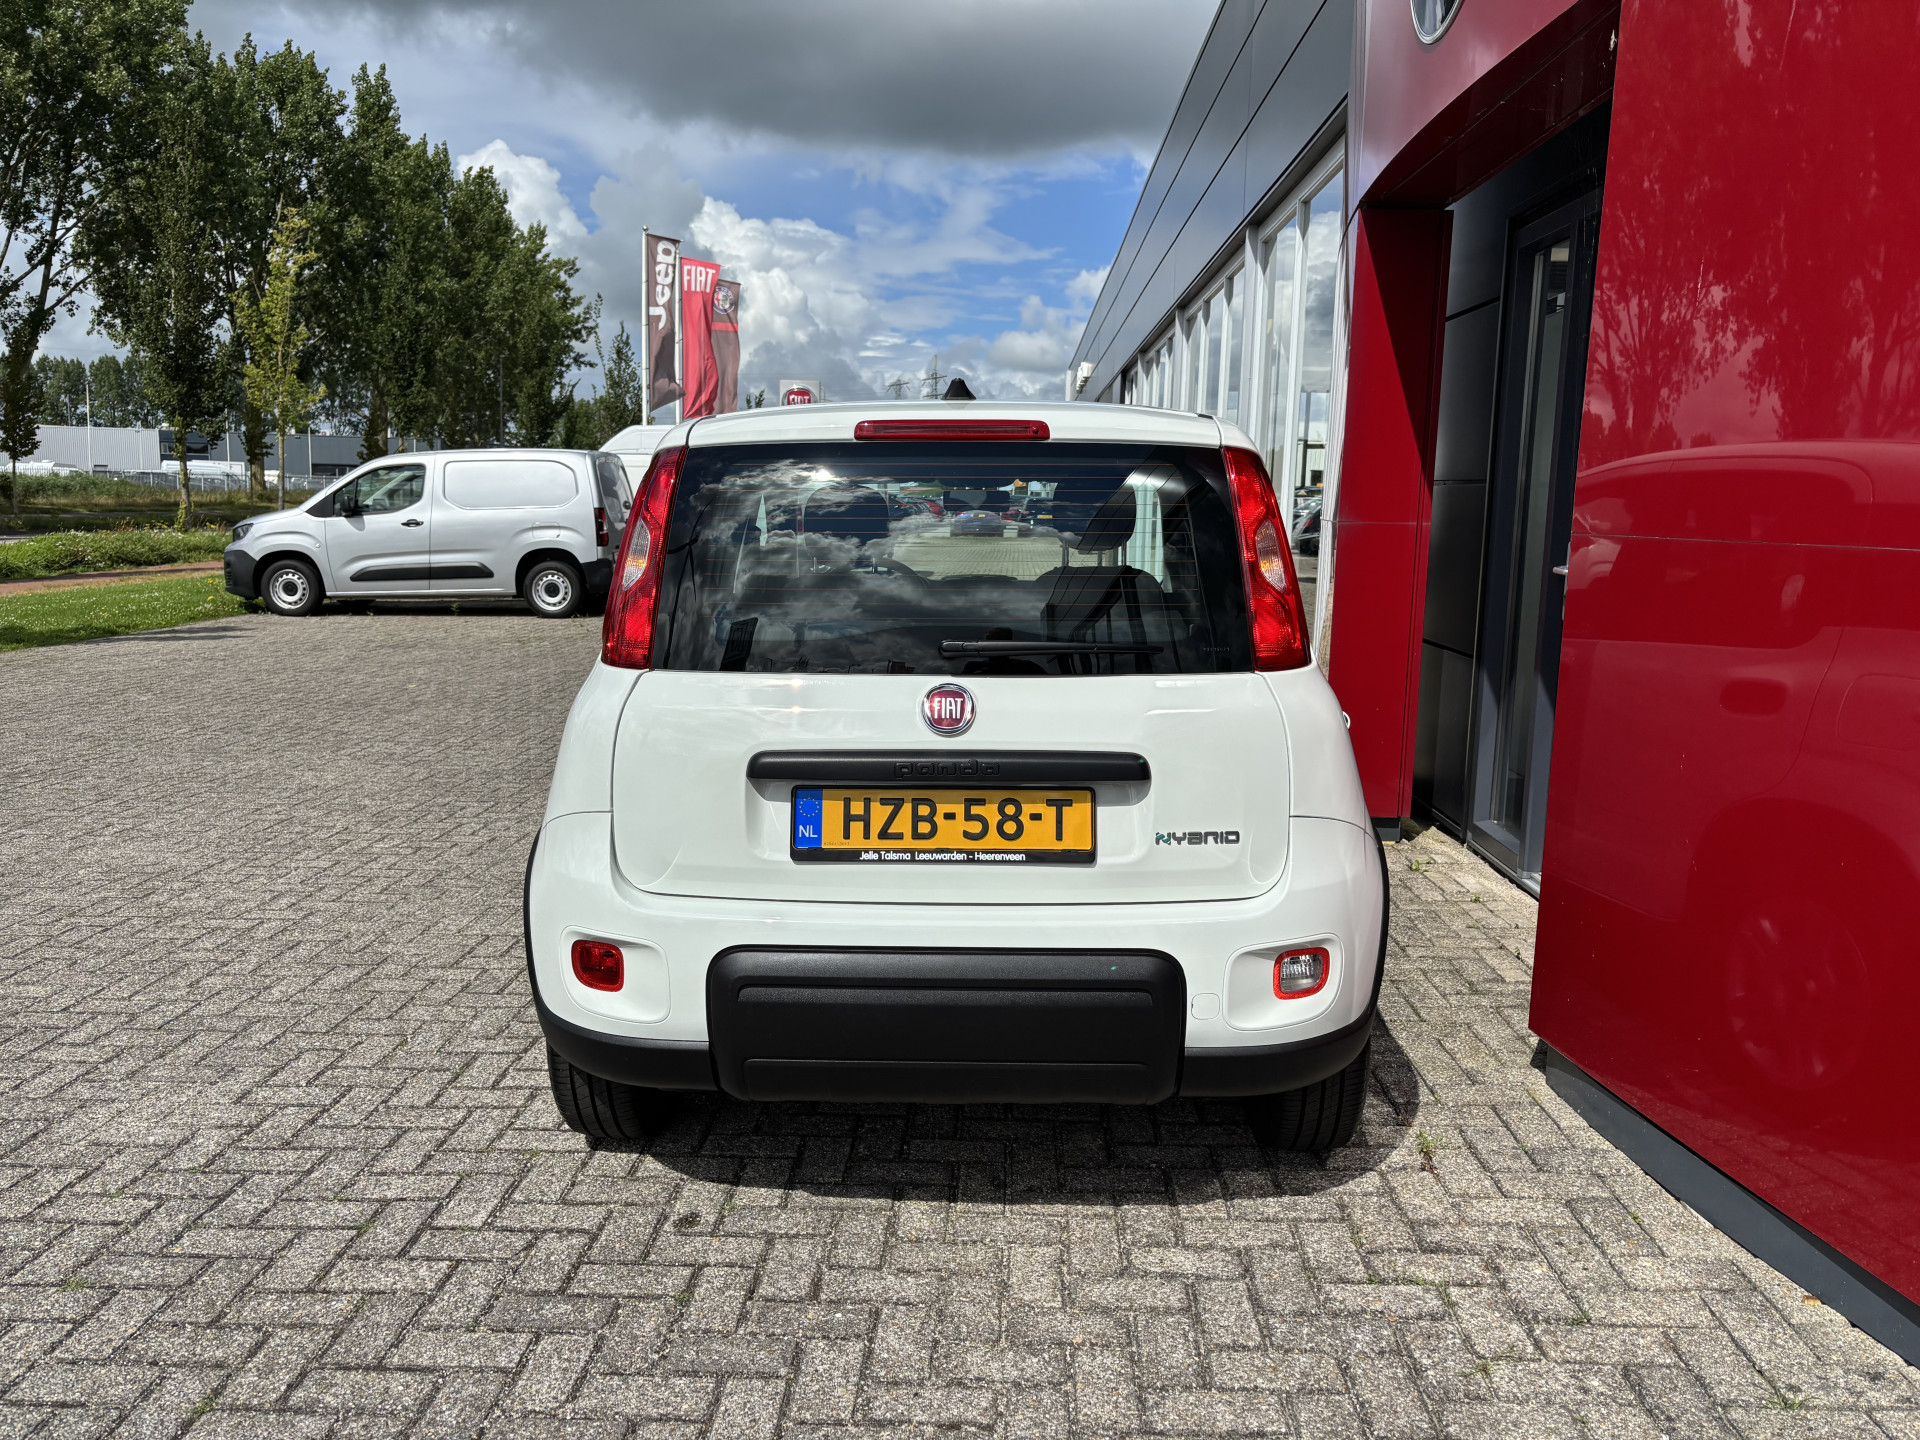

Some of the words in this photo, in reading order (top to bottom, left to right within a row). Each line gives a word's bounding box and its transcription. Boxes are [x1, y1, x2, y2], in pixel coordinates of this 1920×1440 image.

[649, 241, 676, 330] Jeep
[683, 265, 716, 293] FIAT
[934, 698, 964, 719] FIAT
[894, 759, 1000, 779] panda
[842, 797, 1073, 841] HZB-58-T
[798, 825, 818, 838] NL
[1155, 831, 1240, 845] HYBRID
[859, 851, 879, 860] Jelle
[880, 851, 911, 860] Talsma
[915, 851, 967, 861] Leeuwarden
[974, 852, 1026, 861] Heerenveen
